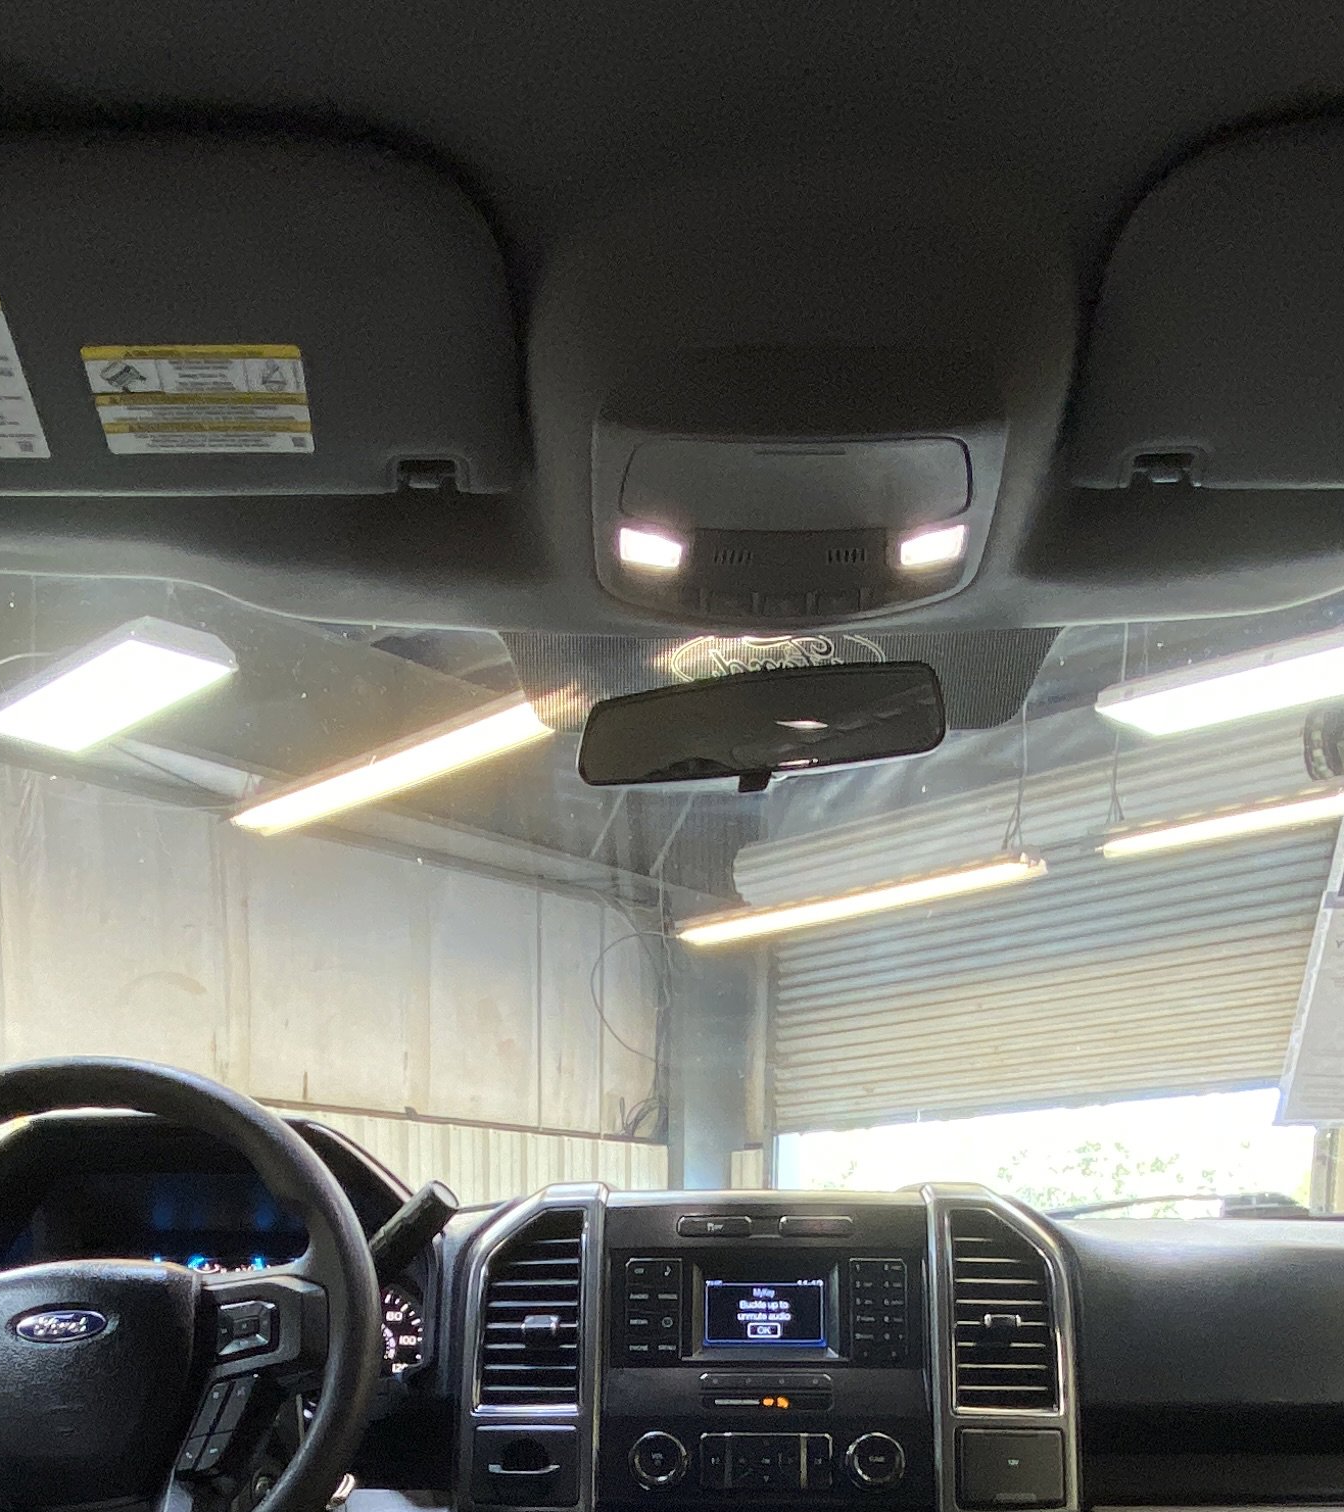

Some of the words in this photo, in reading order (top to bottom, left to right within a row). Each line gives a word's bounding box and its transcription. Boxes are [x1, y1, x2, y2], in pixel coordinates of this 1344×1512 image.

[739, 1300, 767, 1310] Buckle
[767, 1301, 779, 1311] up
[779, 1301, 790, 1310] to
[737, 1313, 767, 1321] unmute
[768, 1312, 792, 1321] audio
[33, 1316, 88, 1336] Ford
[756, 1326, 772, 1335] OK
[399, 1335, 416, 1345] 100
